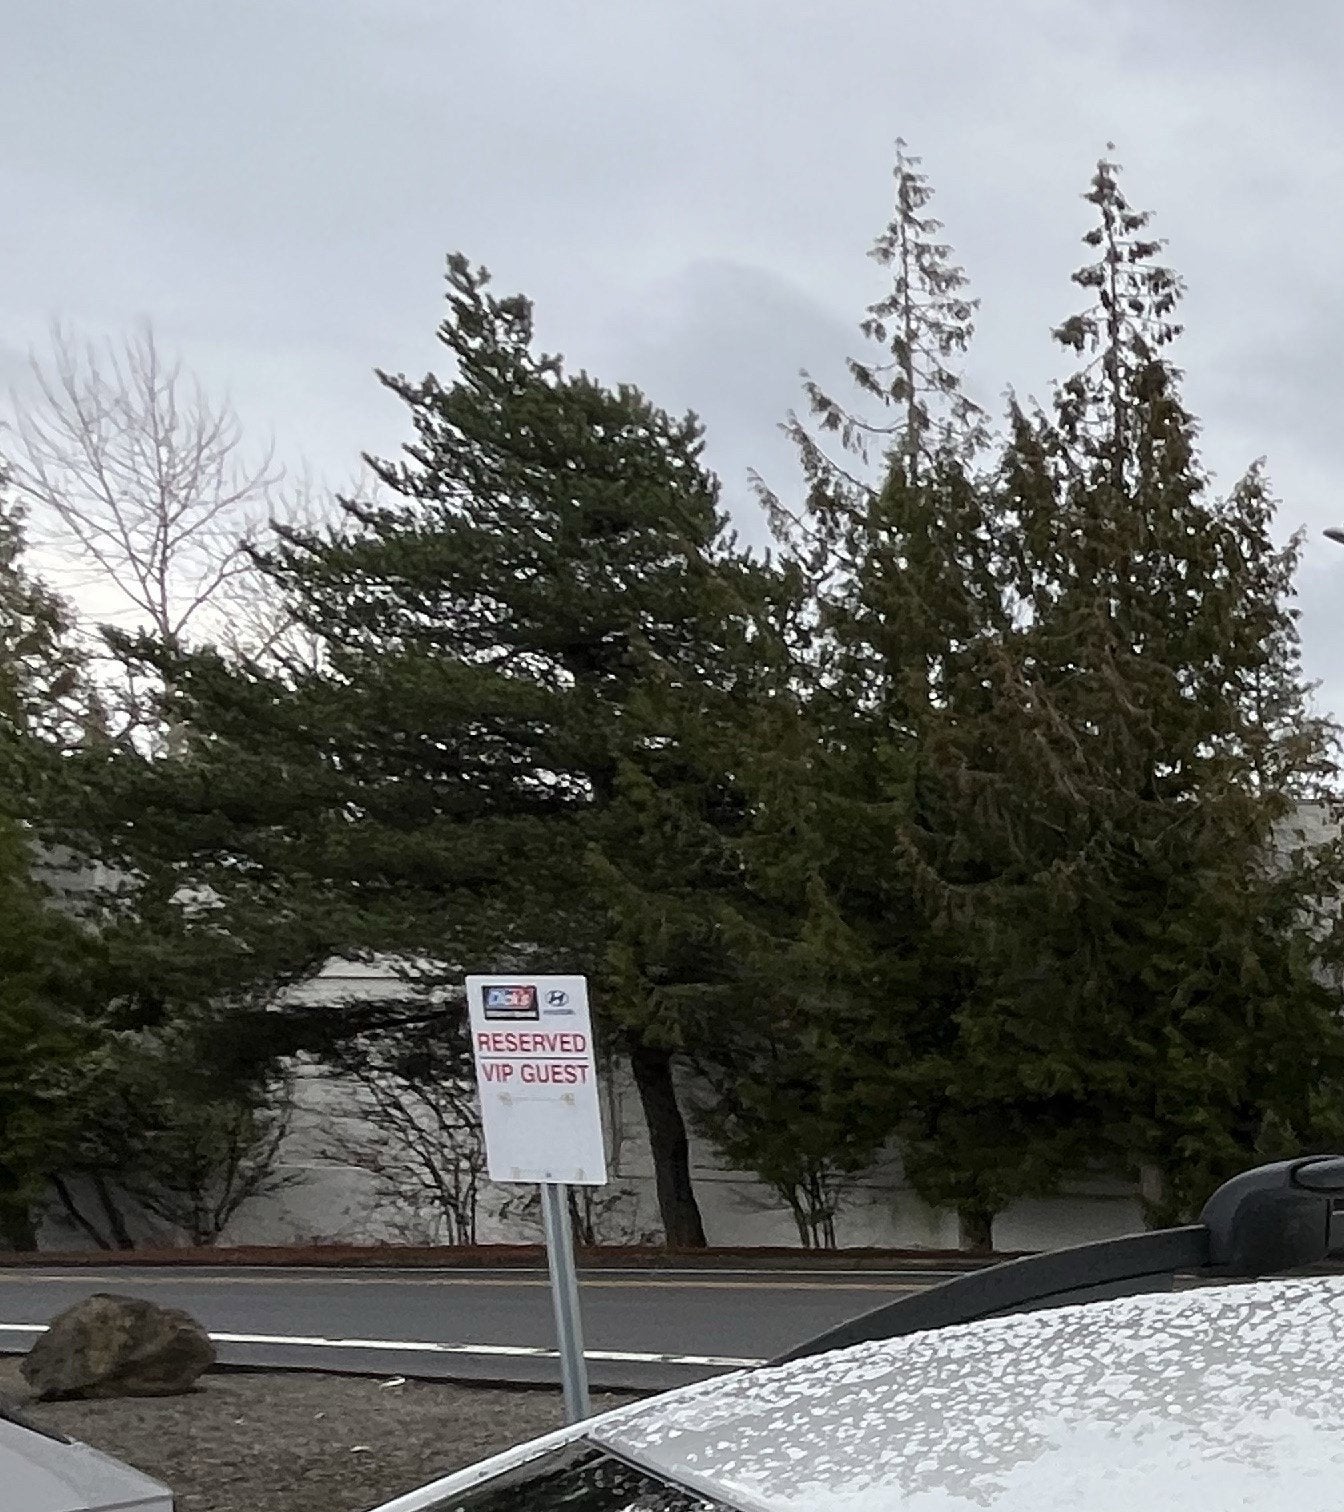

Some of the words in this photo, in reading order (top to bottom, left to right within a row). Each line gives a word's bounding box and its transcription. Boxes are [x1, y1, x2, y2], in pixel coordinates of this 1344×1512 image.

[477, 1032, 587, 1052] RESERVED
[481, 1064, 514, 1082] VIP
[520, 1064, 590, 1084] GUEST
